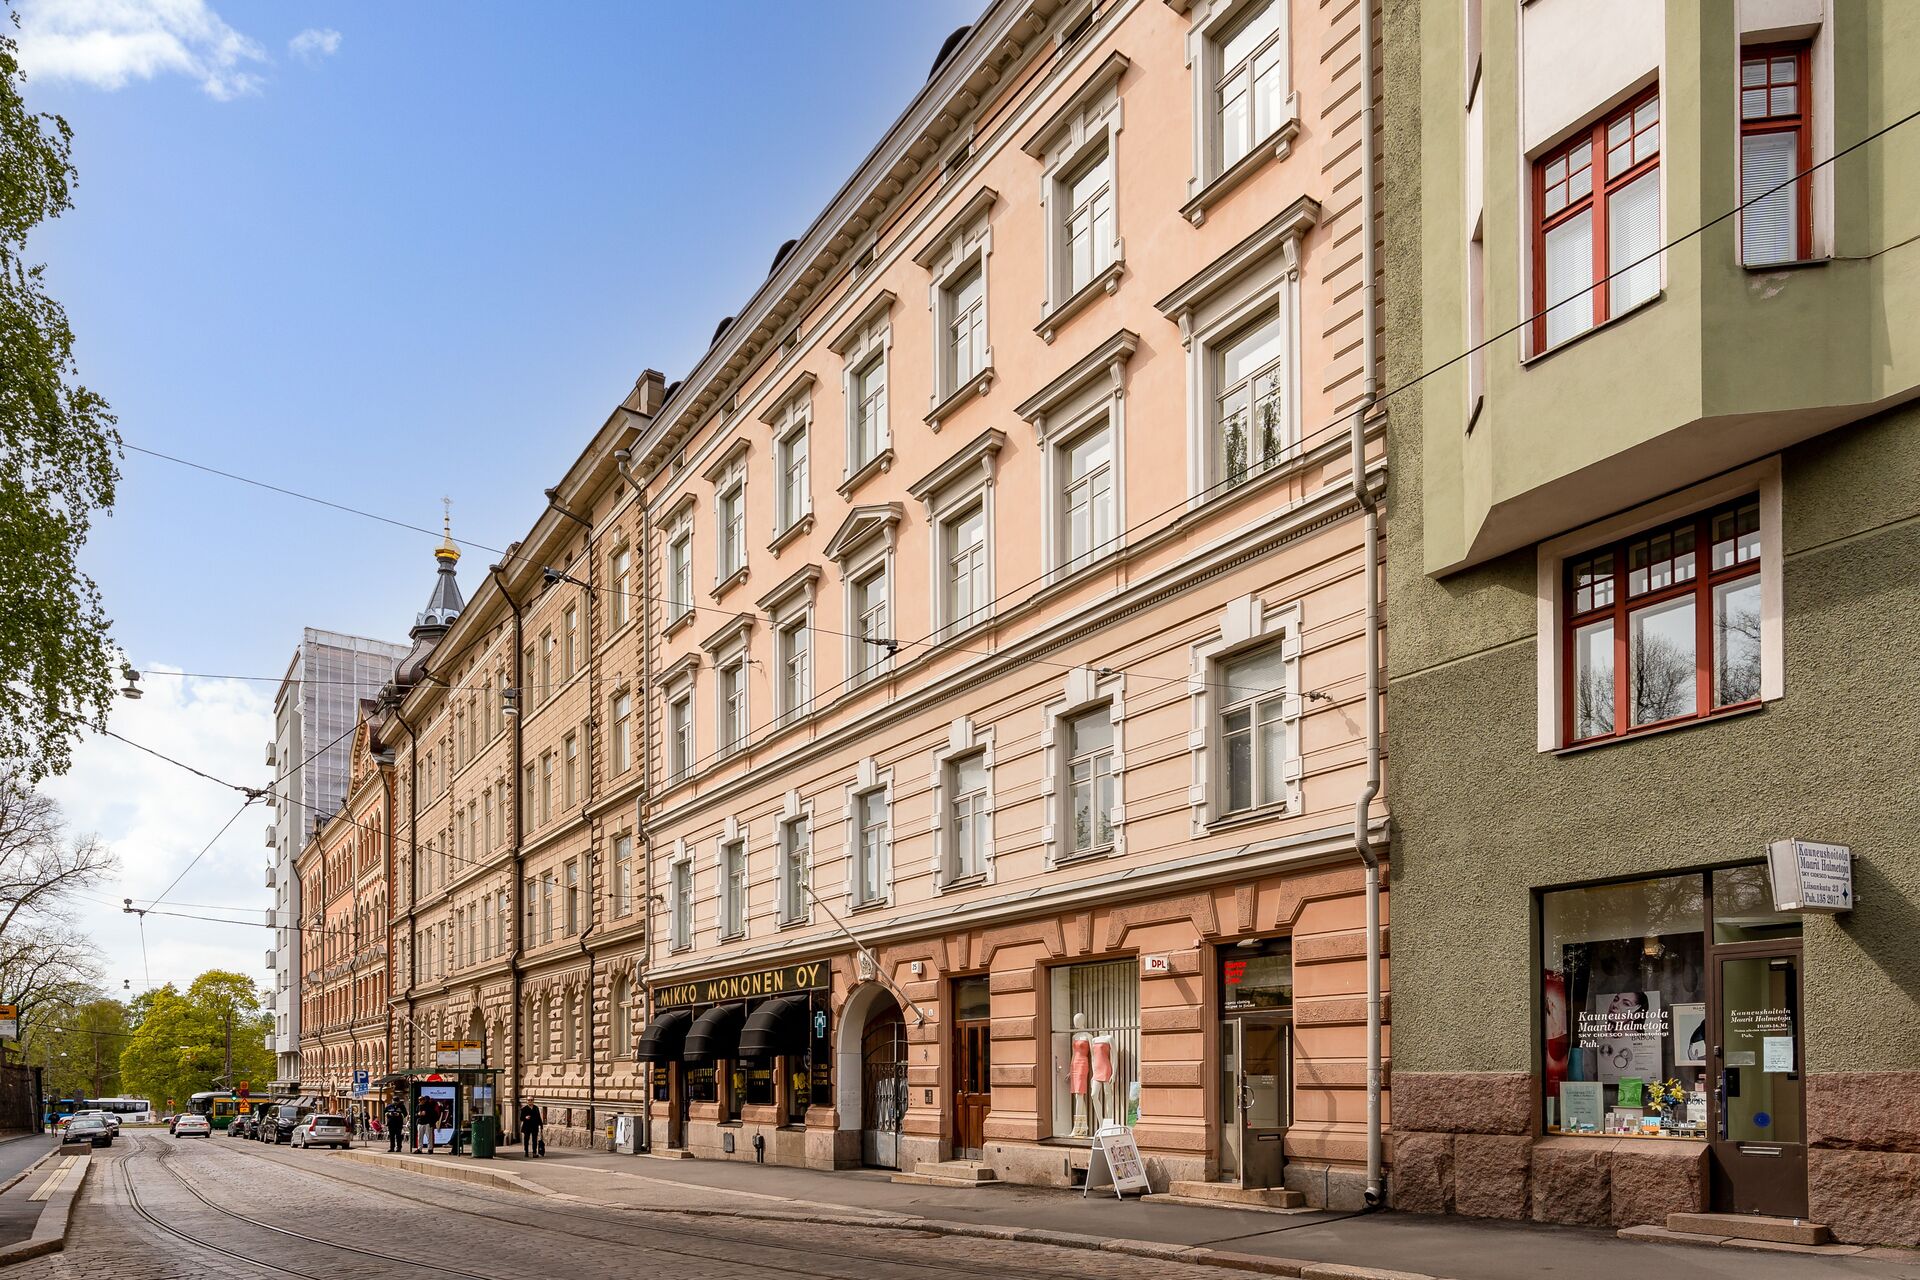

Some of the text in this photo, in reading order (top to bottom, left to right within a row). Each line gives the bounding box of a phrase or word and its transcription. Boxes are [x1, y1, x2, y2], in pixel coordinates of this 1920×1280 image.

[1798, 844, 1848, 861] Kauneushoitola
[1800, 857, 1849, 877] Maarit Halmetoja
[1151, 959, 1166, 969] DPL
[660, 963, 820, 1007] MIKKO MONONEN OY
[1578, 1009, 1669, 1022] Kauneushoitola
[1730, 1008, 1791, 1017] Kauneushoitola
[1755, 1014, 1791, 1023] Halmetoja
[1578, 1020, 1669, 1034] Maarit Halmetoja
[1579, 1040, 1600, 1048] Puh.
